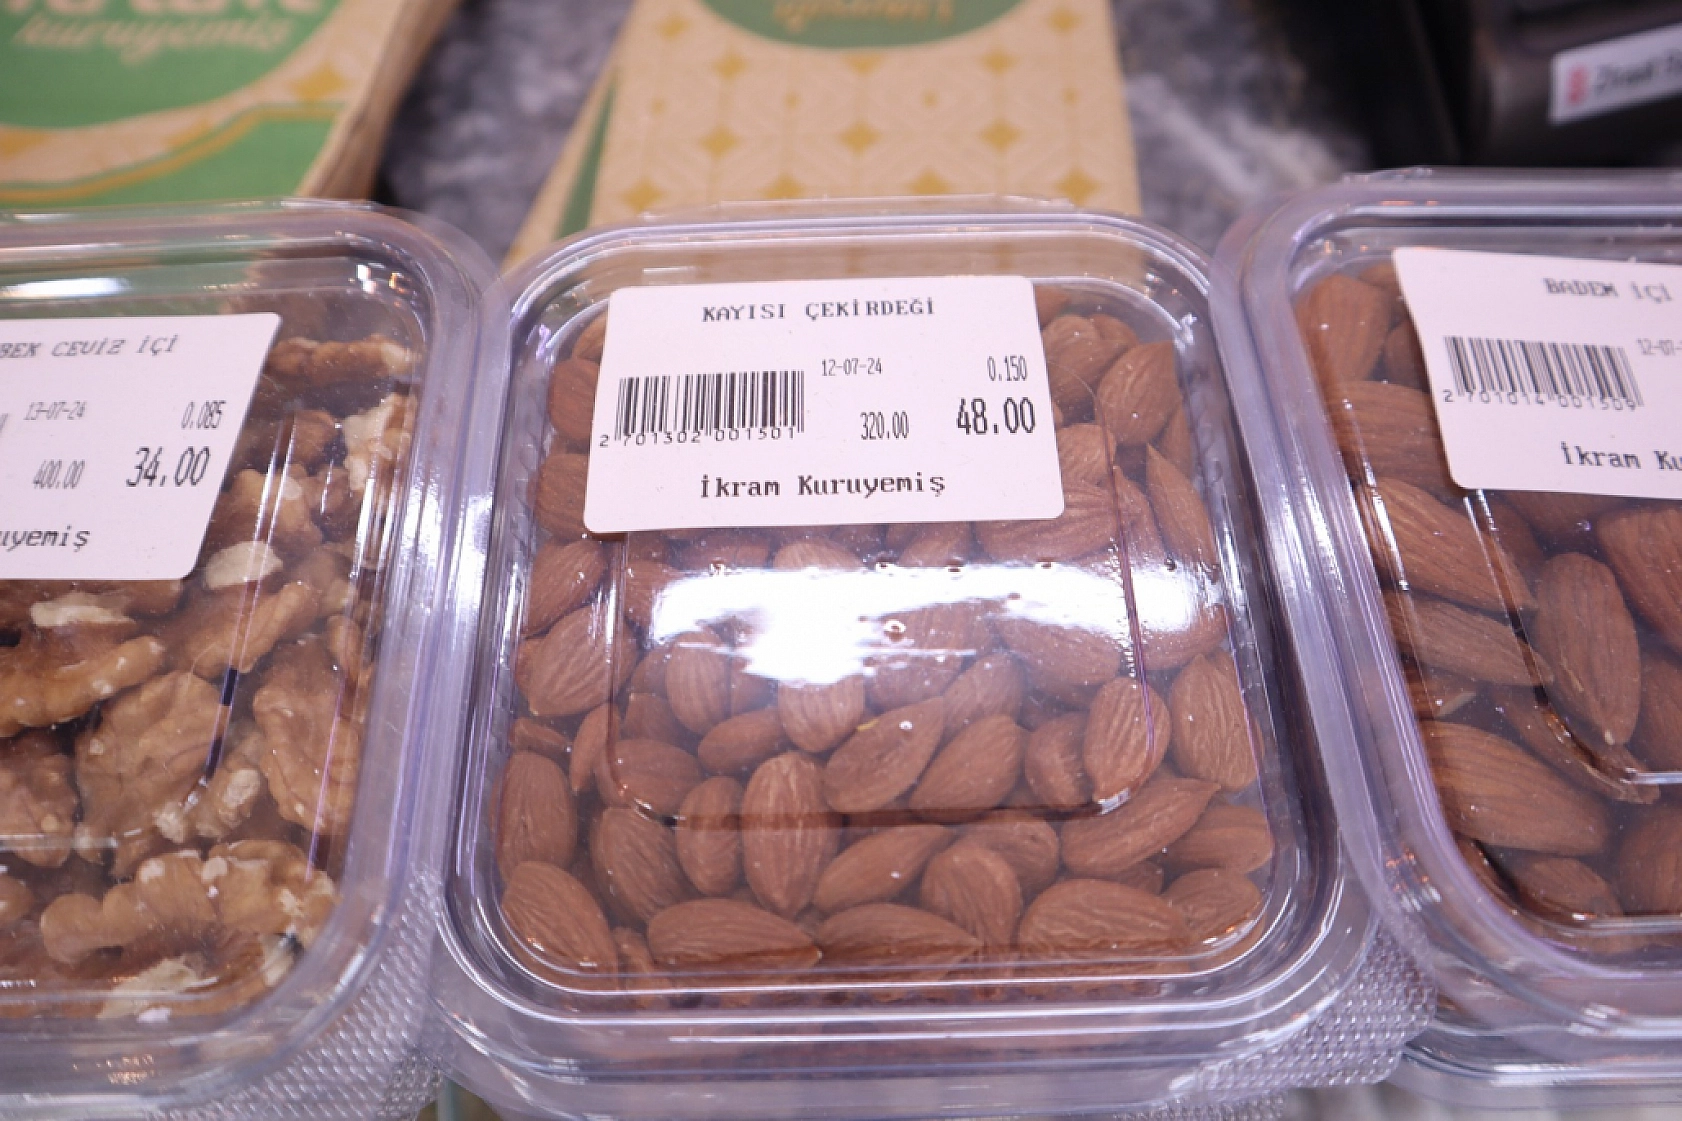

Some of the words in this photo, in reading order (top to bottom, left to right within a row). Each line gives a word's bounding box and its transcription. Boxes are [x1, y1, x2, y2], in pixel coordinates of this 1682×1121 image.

[1543, 277, 1619, 297] BADEM
[702, 303, 786, 322] KAYISI
[805, 296, 935, 321] ÇEKİRDEĞİ
[821, 357, 882, 376] 12-07-24
[987, 355, 1027, 381] 0.150
[24, 401, 86, 421] 13-07-24
[181, 399, 226, 430] 0.085
[956, 397, 1035, 434] 48.00
[860, 411, 909, 440] 320.00
[599, 434, 609, 448] 2
[125, 446, 210, 488] 34.00
[1560, 440, 1642, 470] İkram
[33, 459, 85, 490] 400.00
[701, 474, 780, 498] İkram
[798, 471, 946, 498] Kuruyemiş
